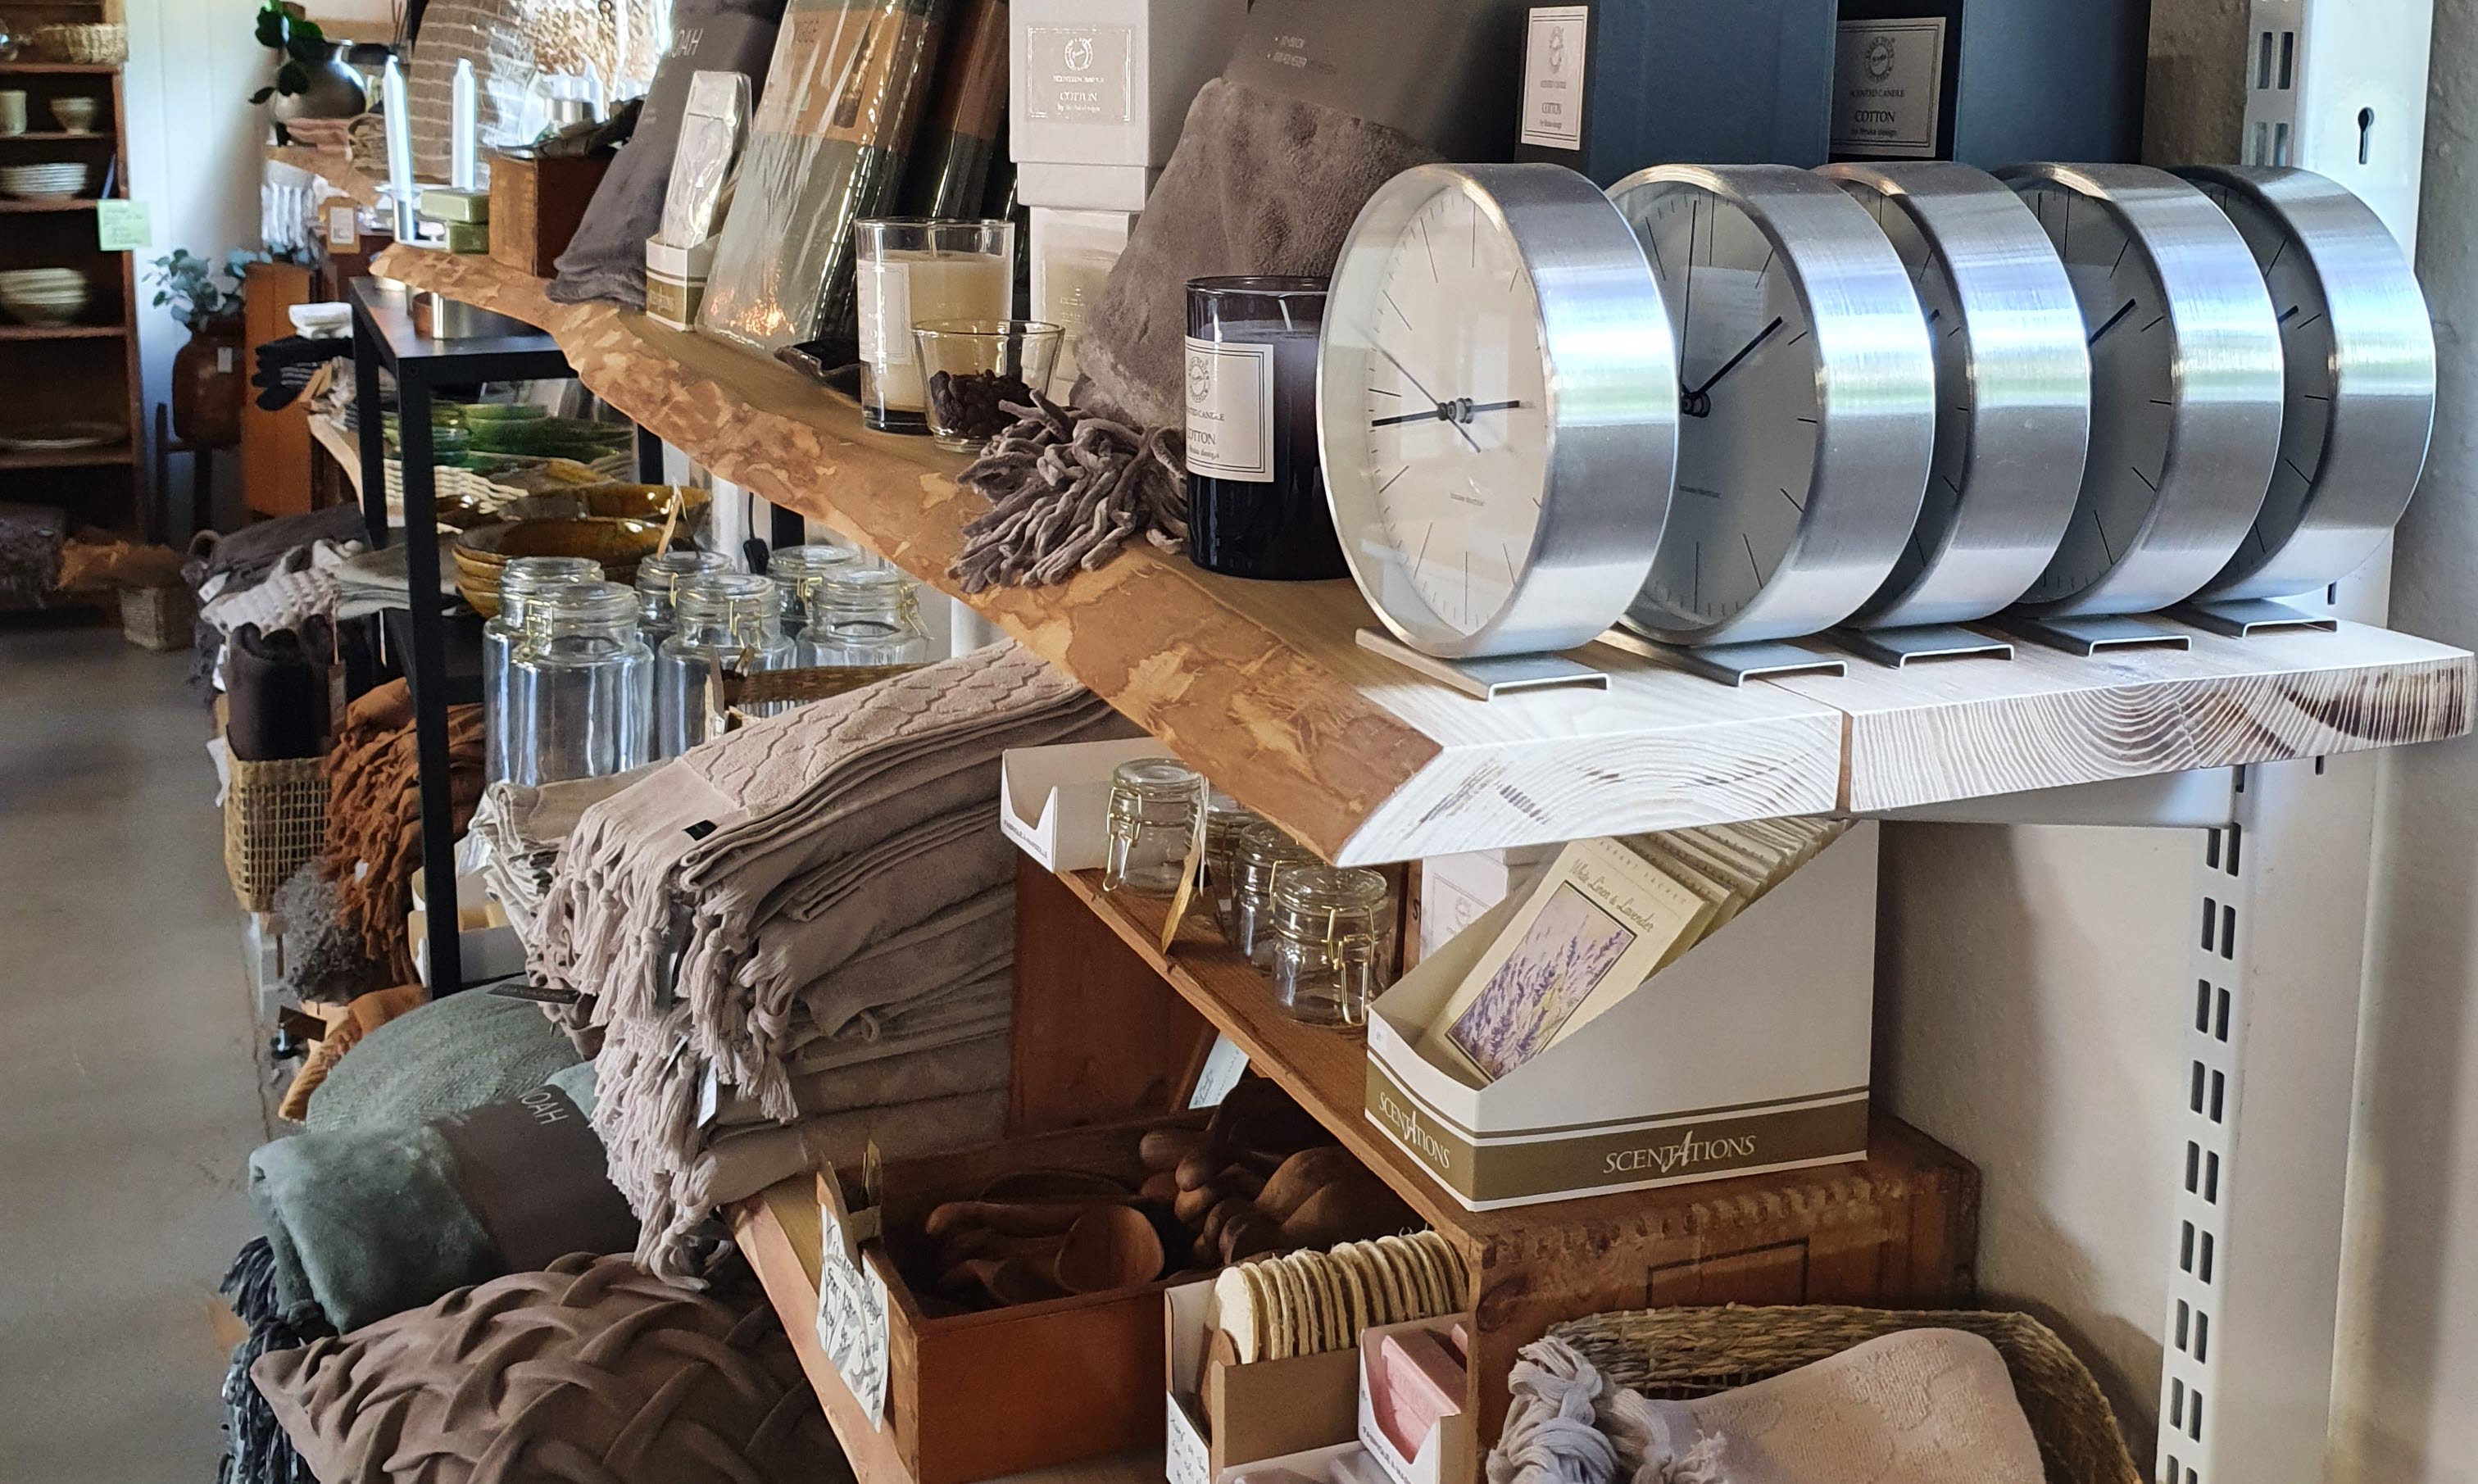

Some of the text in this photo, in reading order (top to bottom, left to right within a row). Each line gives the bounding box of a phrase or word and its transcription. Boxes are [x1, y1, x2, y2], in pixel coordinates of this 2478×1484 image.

[669, 27, 704, 57] OAH
[1060, 91, 1097, 102] COTTON
[1855, 111, 1895, 123] COTTON
[1617, 897, 1655, 933] Lavender
[1379, 1091, 1450, 1169] SCENTATIONS
[1603, 1130, 1757, 1174] SCENTATIONS
